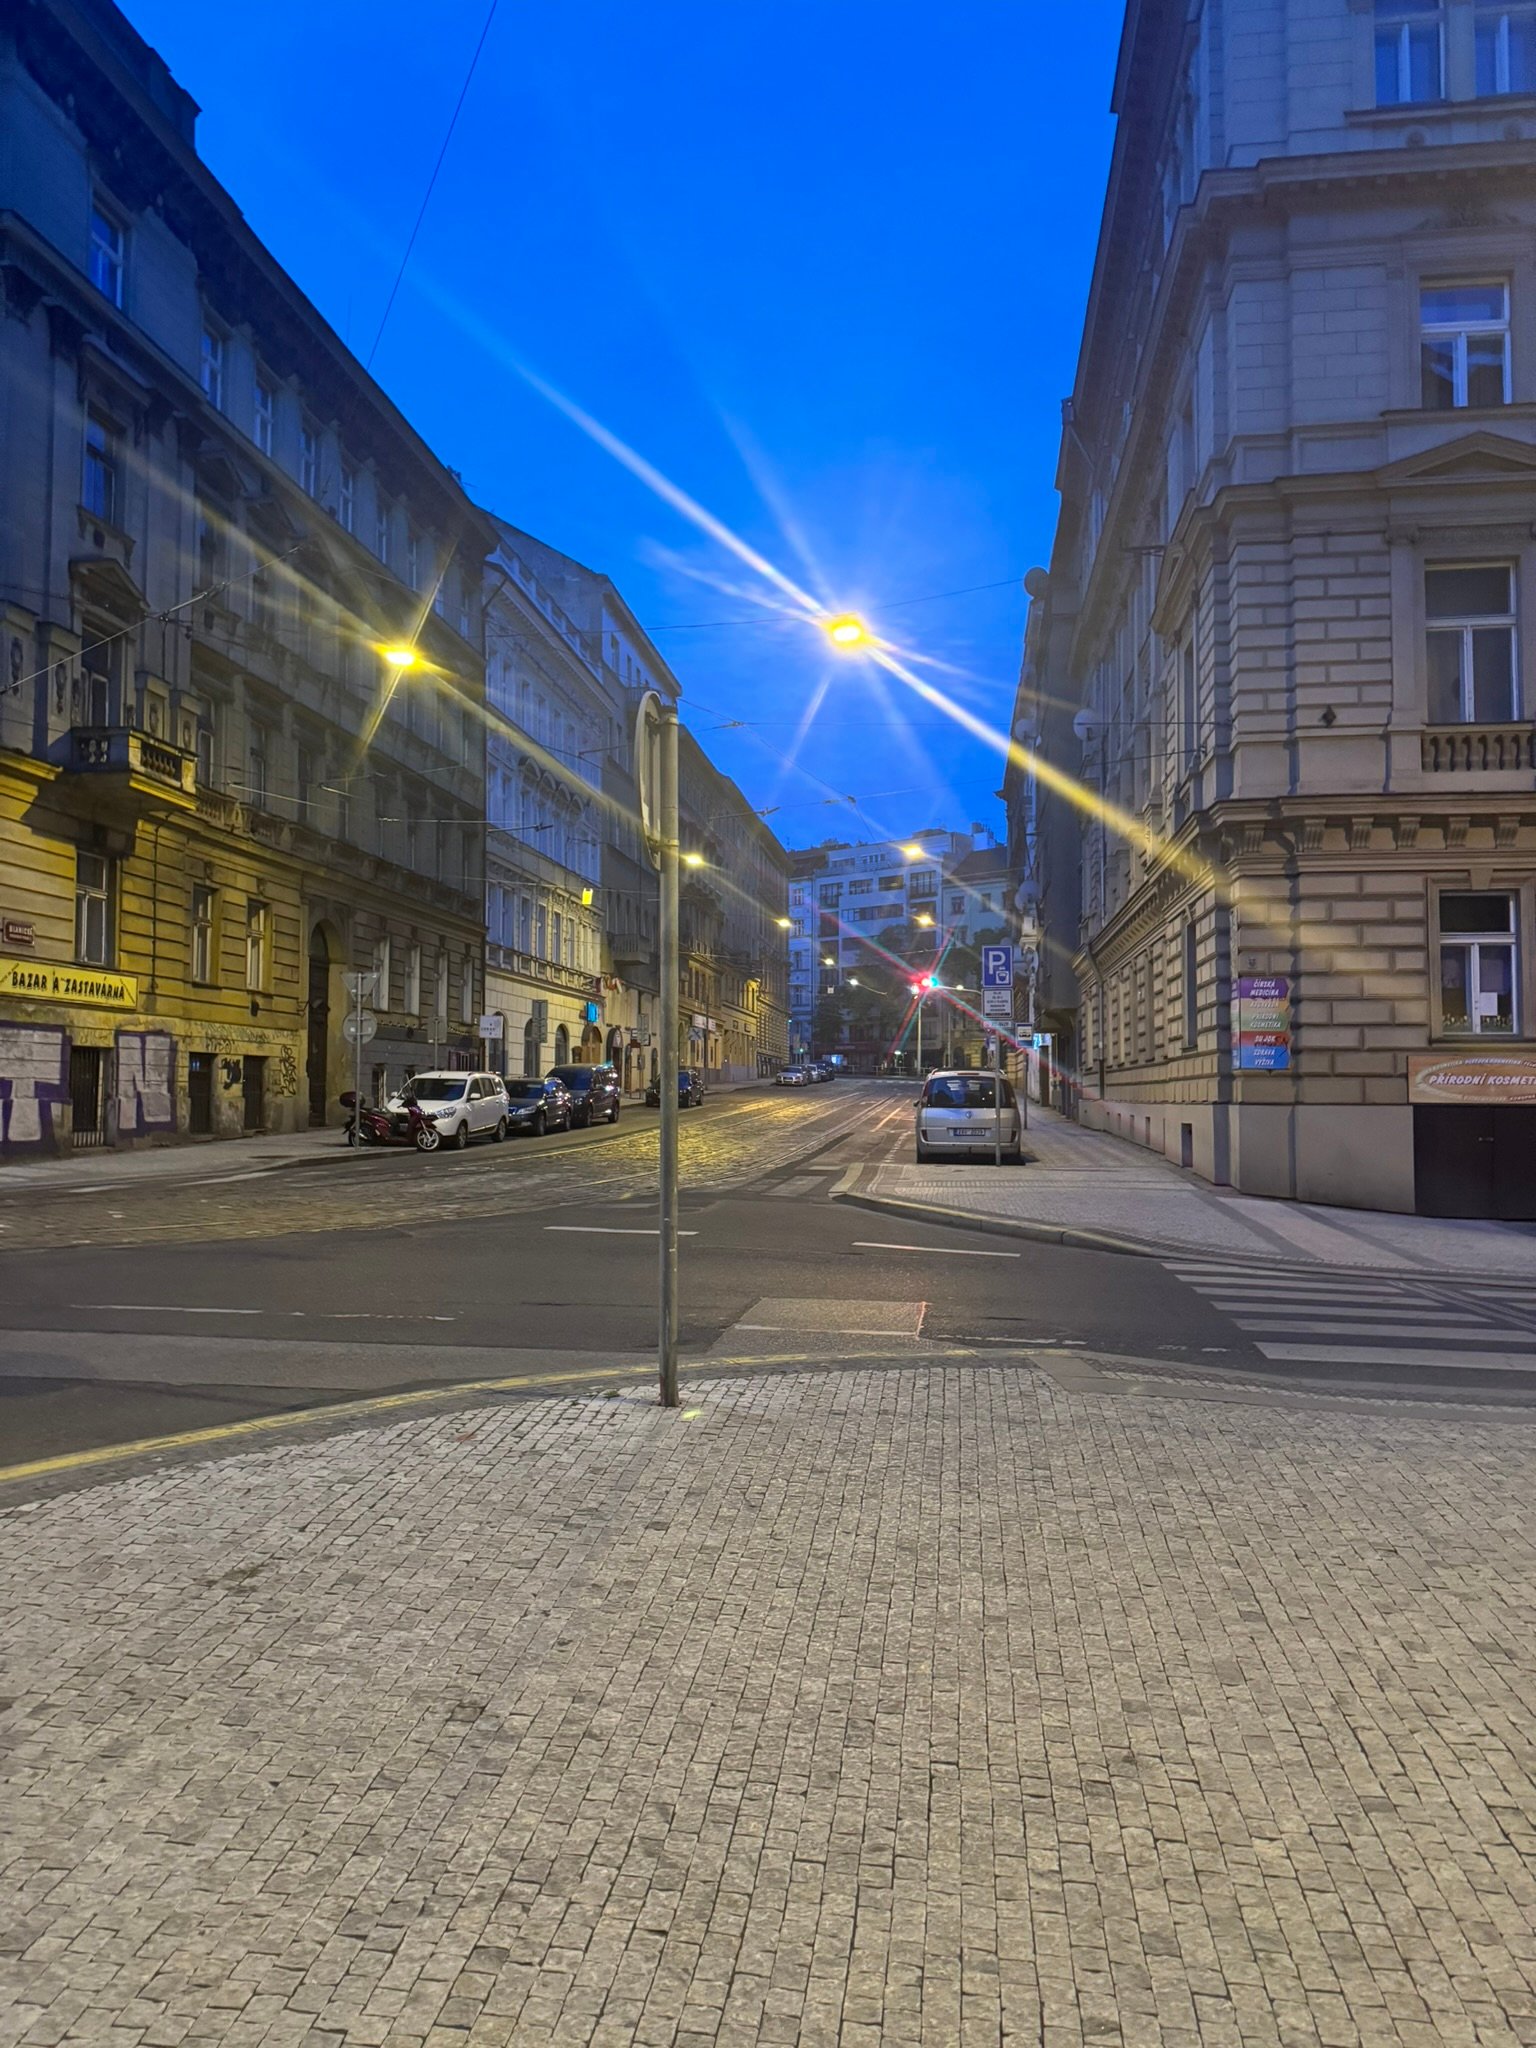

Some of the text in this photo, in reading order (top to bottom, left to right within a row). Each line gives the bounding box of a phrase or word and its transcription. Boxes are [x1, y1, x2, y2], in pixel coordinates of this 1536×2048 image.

[988, 951, 1006, 975] P
[12, 971, 47, 990] BAZAR
[64, 977, 125, 999] ZASTAVÁRNA
[1428, 1073, 1486, 1085] PŘÍRODNÍ
